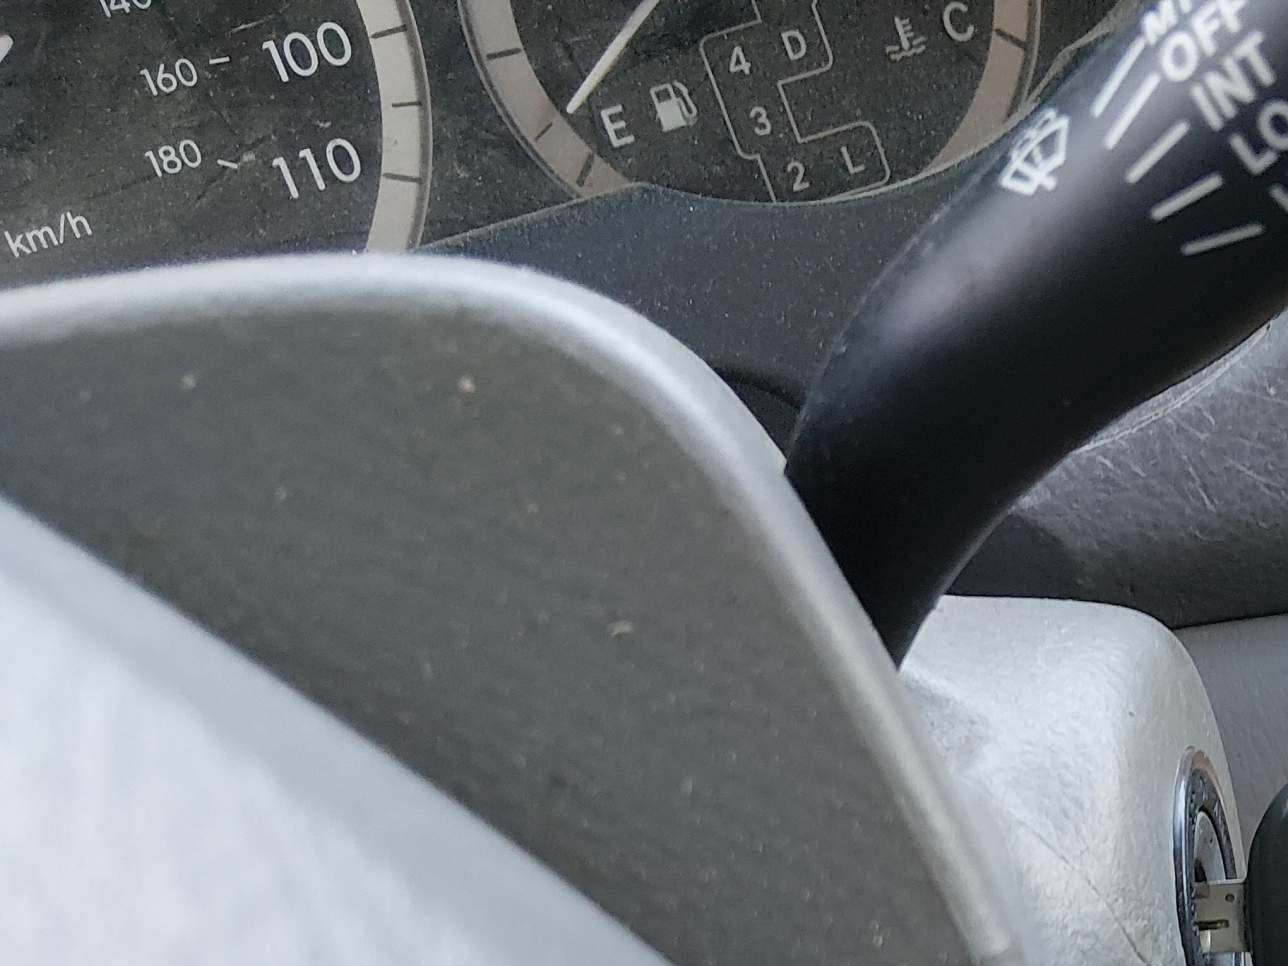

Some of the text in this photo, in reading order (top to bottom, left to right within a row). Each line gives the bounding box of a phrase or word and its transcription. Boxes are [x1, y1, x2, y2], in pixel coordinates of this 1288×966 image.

[942, 2, 975, 43] C
[262, 21, 353, 82] 100
[728, 46, 751, 77] 4
[781, 30, 808, 61] D
[140, 58, 198, 96] 160
[1190, 30, 1277, 132] INT
[600, 104, 635, 149] E
[749, 106, 773, 136] 3
[145, 139, 202, 178] 180
[272, 137, 362, 200] 110
[787, 162, 810, 193] 2
[841, 147, 866, 175] L
[4, 211, 93, 258] km/h
